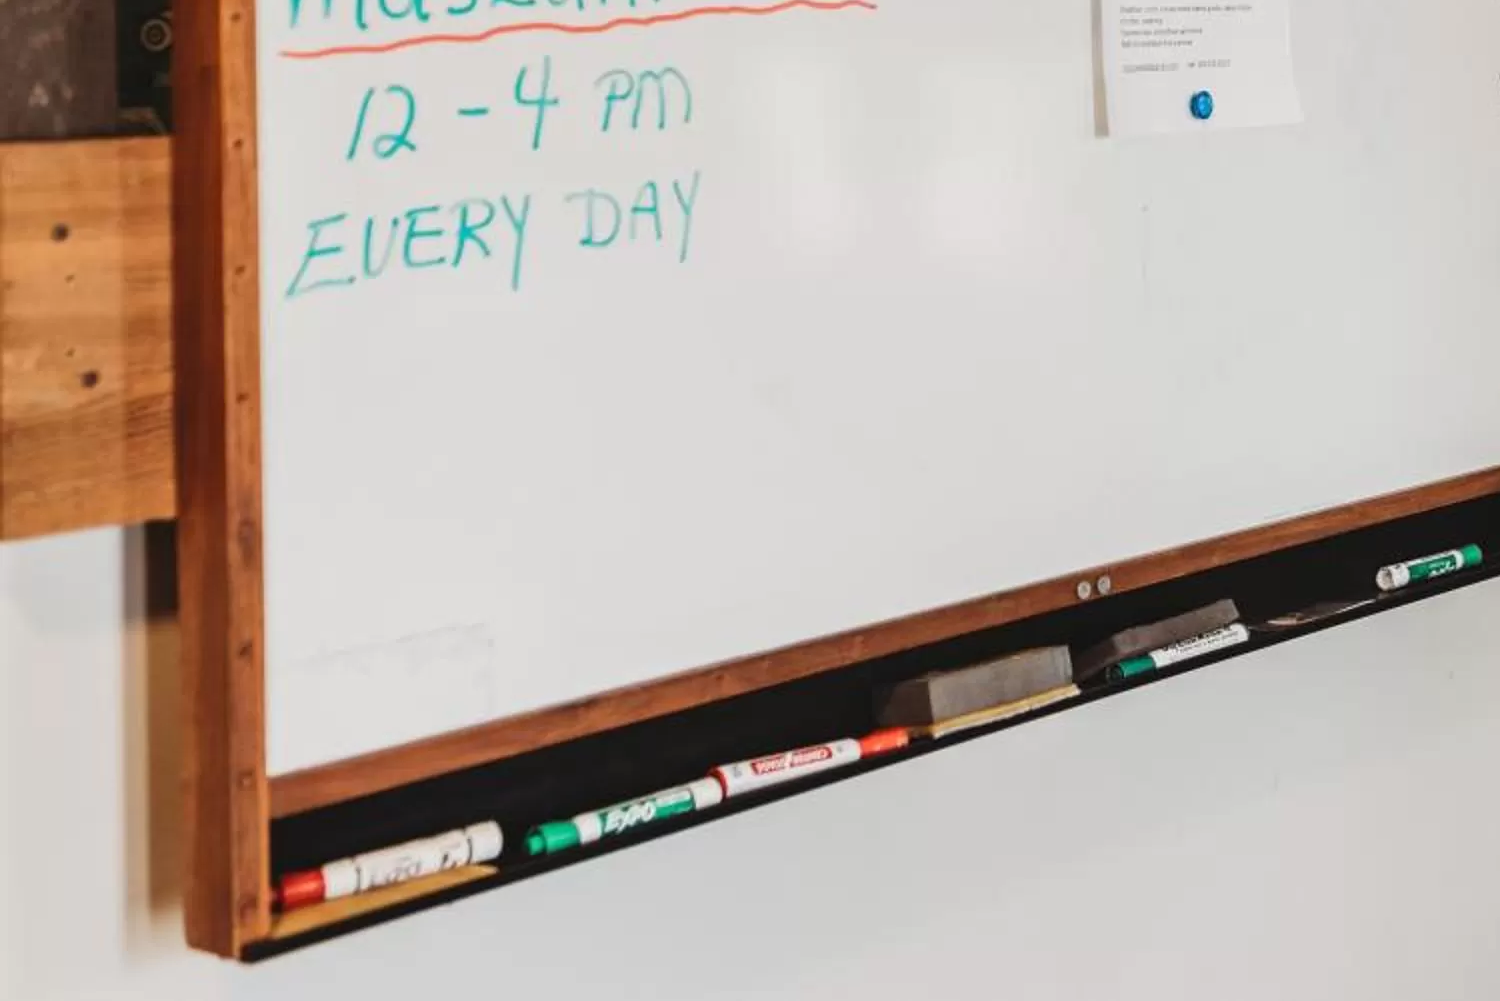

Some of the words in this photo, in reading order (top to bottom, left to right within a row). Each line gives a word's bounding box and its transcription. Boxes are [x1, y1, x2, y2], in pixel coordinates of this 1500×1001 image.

[345, 83, 418, 163] 12
[512, 54, 561, 152] 4
[284, 193, 531, 299] EVERY
[565, 171, 701, 264] DAY
[603, 799, 657, 834] EXPO
